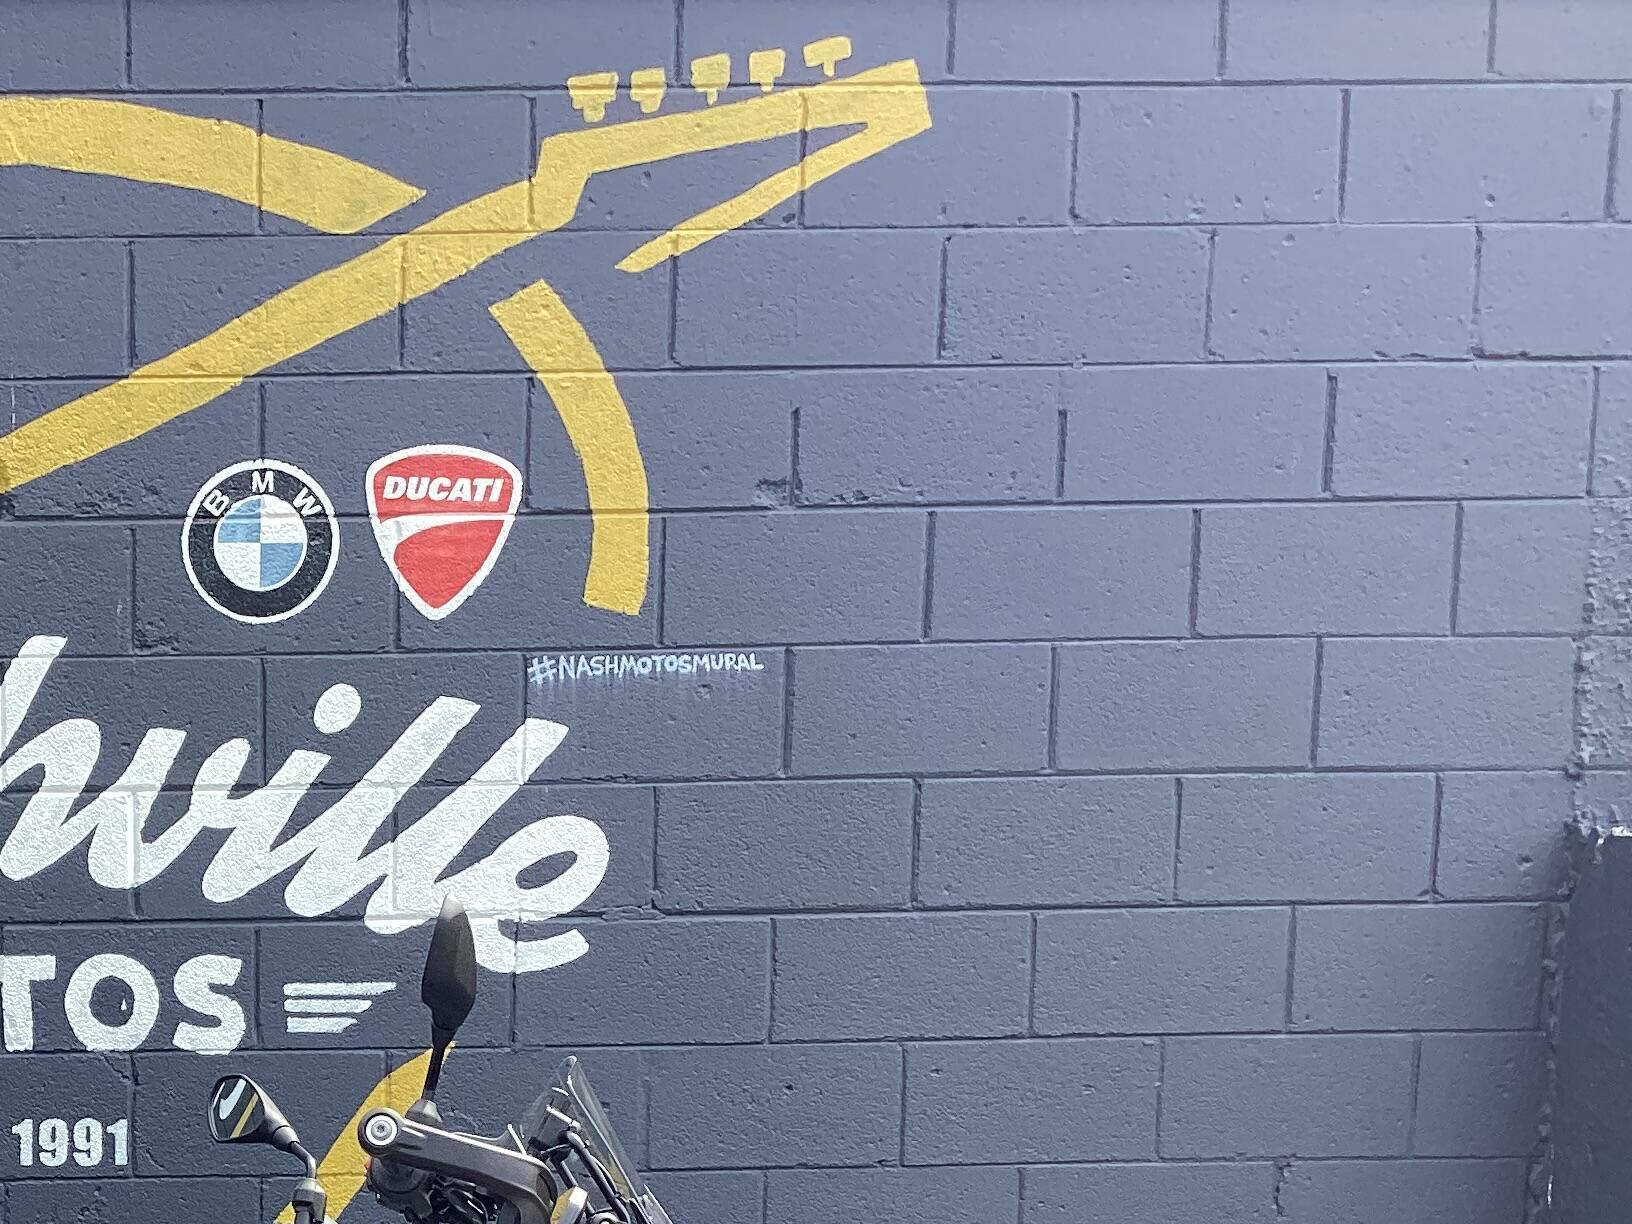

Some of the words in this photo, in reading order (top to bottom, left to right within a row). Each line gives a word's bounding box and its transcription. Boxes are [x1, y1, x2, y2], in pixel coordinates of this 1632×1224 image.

[202, 470, 325, 517] BMW
[383, 476, 504, 502] DUCATI
[527, 653, 764, 686] #NASHMOTOSMURAL
[12, 1117, 128, 1167] 1991
